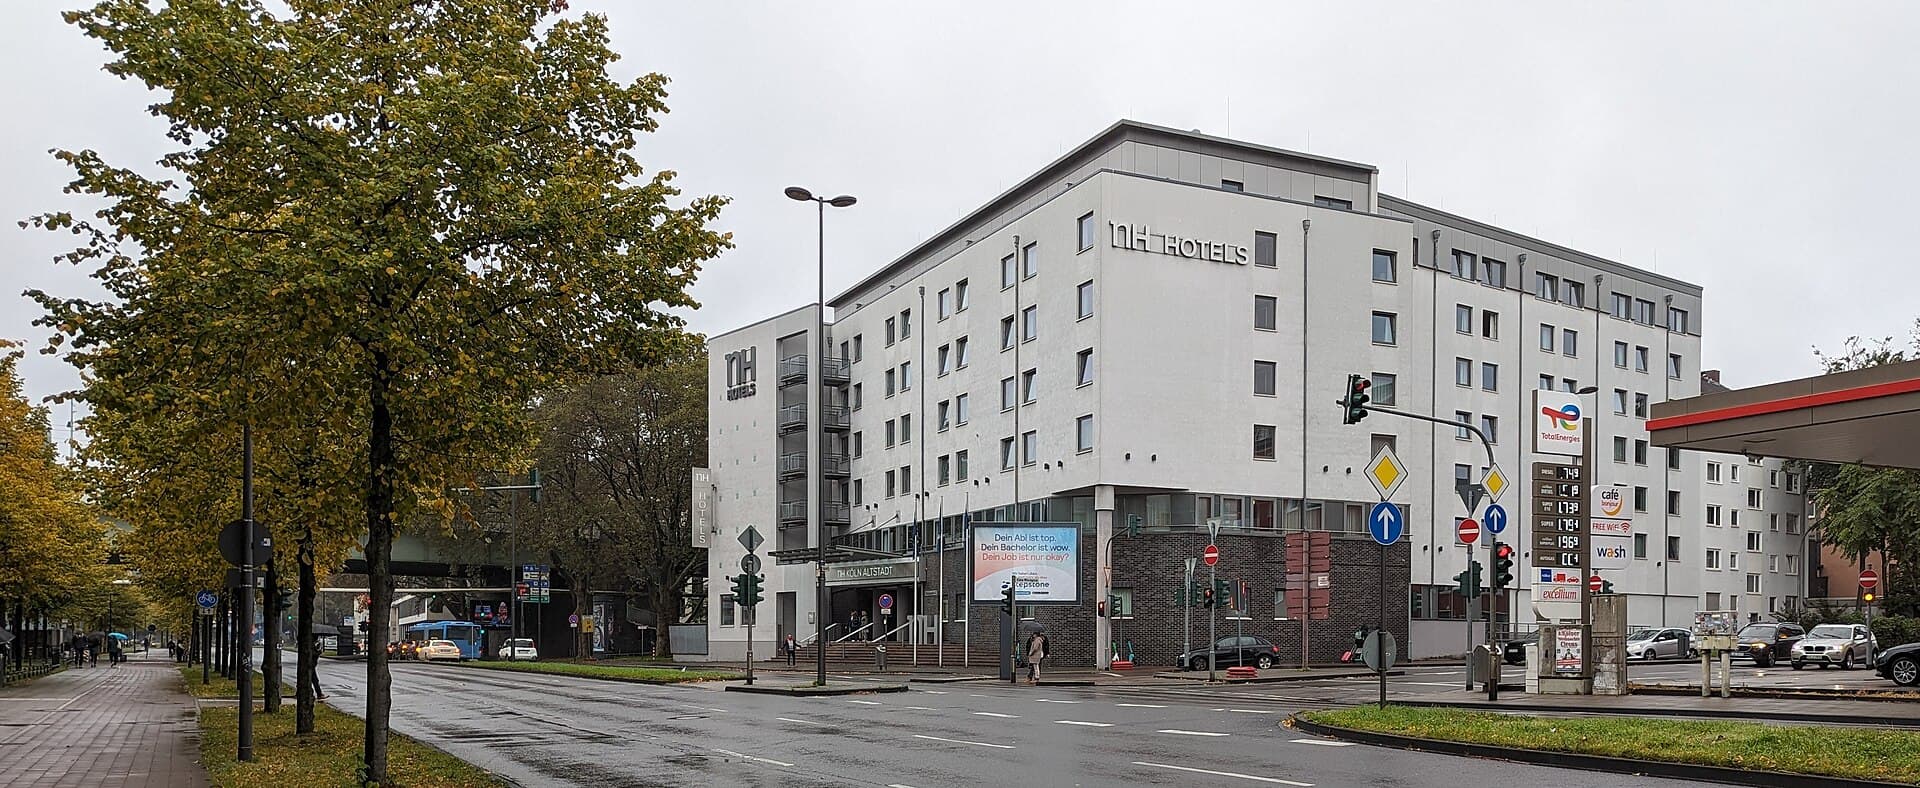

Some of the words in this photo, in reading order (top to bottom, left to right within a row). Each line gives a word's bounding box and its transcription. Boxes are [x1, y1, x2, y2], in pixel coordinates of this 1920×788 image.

[1163, 234, 1249, 265] HOTELS
[727, 383, 756, 401] HOTELS
[1541, 433, 1580, 443] TotalEnergies
[1601, 489, 1619, 500] café
[699, 491, 707, 545] HOTELS
[1592, 523, 1606, 531] FREE
[994, 533, 1013, 542] Dein
[1014, 533, 1028, 542] Abi
[1028, 533, 1039, 542] ist
[1040, 534, 1057, 544] top.
[981, 543, 999, 551] Dein
[1000, 543, 1036, 551] Bachelor
[1038, 543, 1049, 551] ist
[1596, 545, 1626, 558] wash
[982, 553, 1000, 561] Dein
[1001, 553, 1018, 561] Job
[1018, 553, 1029, 561] ist
[1045, 553, 1070, 562] okay?
[846, 568, 862, 578] KÖLN
[863, 566, 893, 577] ALTSTADT
[1015, 581, 1050, 589] tepstone
[1543, 587, 1577, 600] excellium
